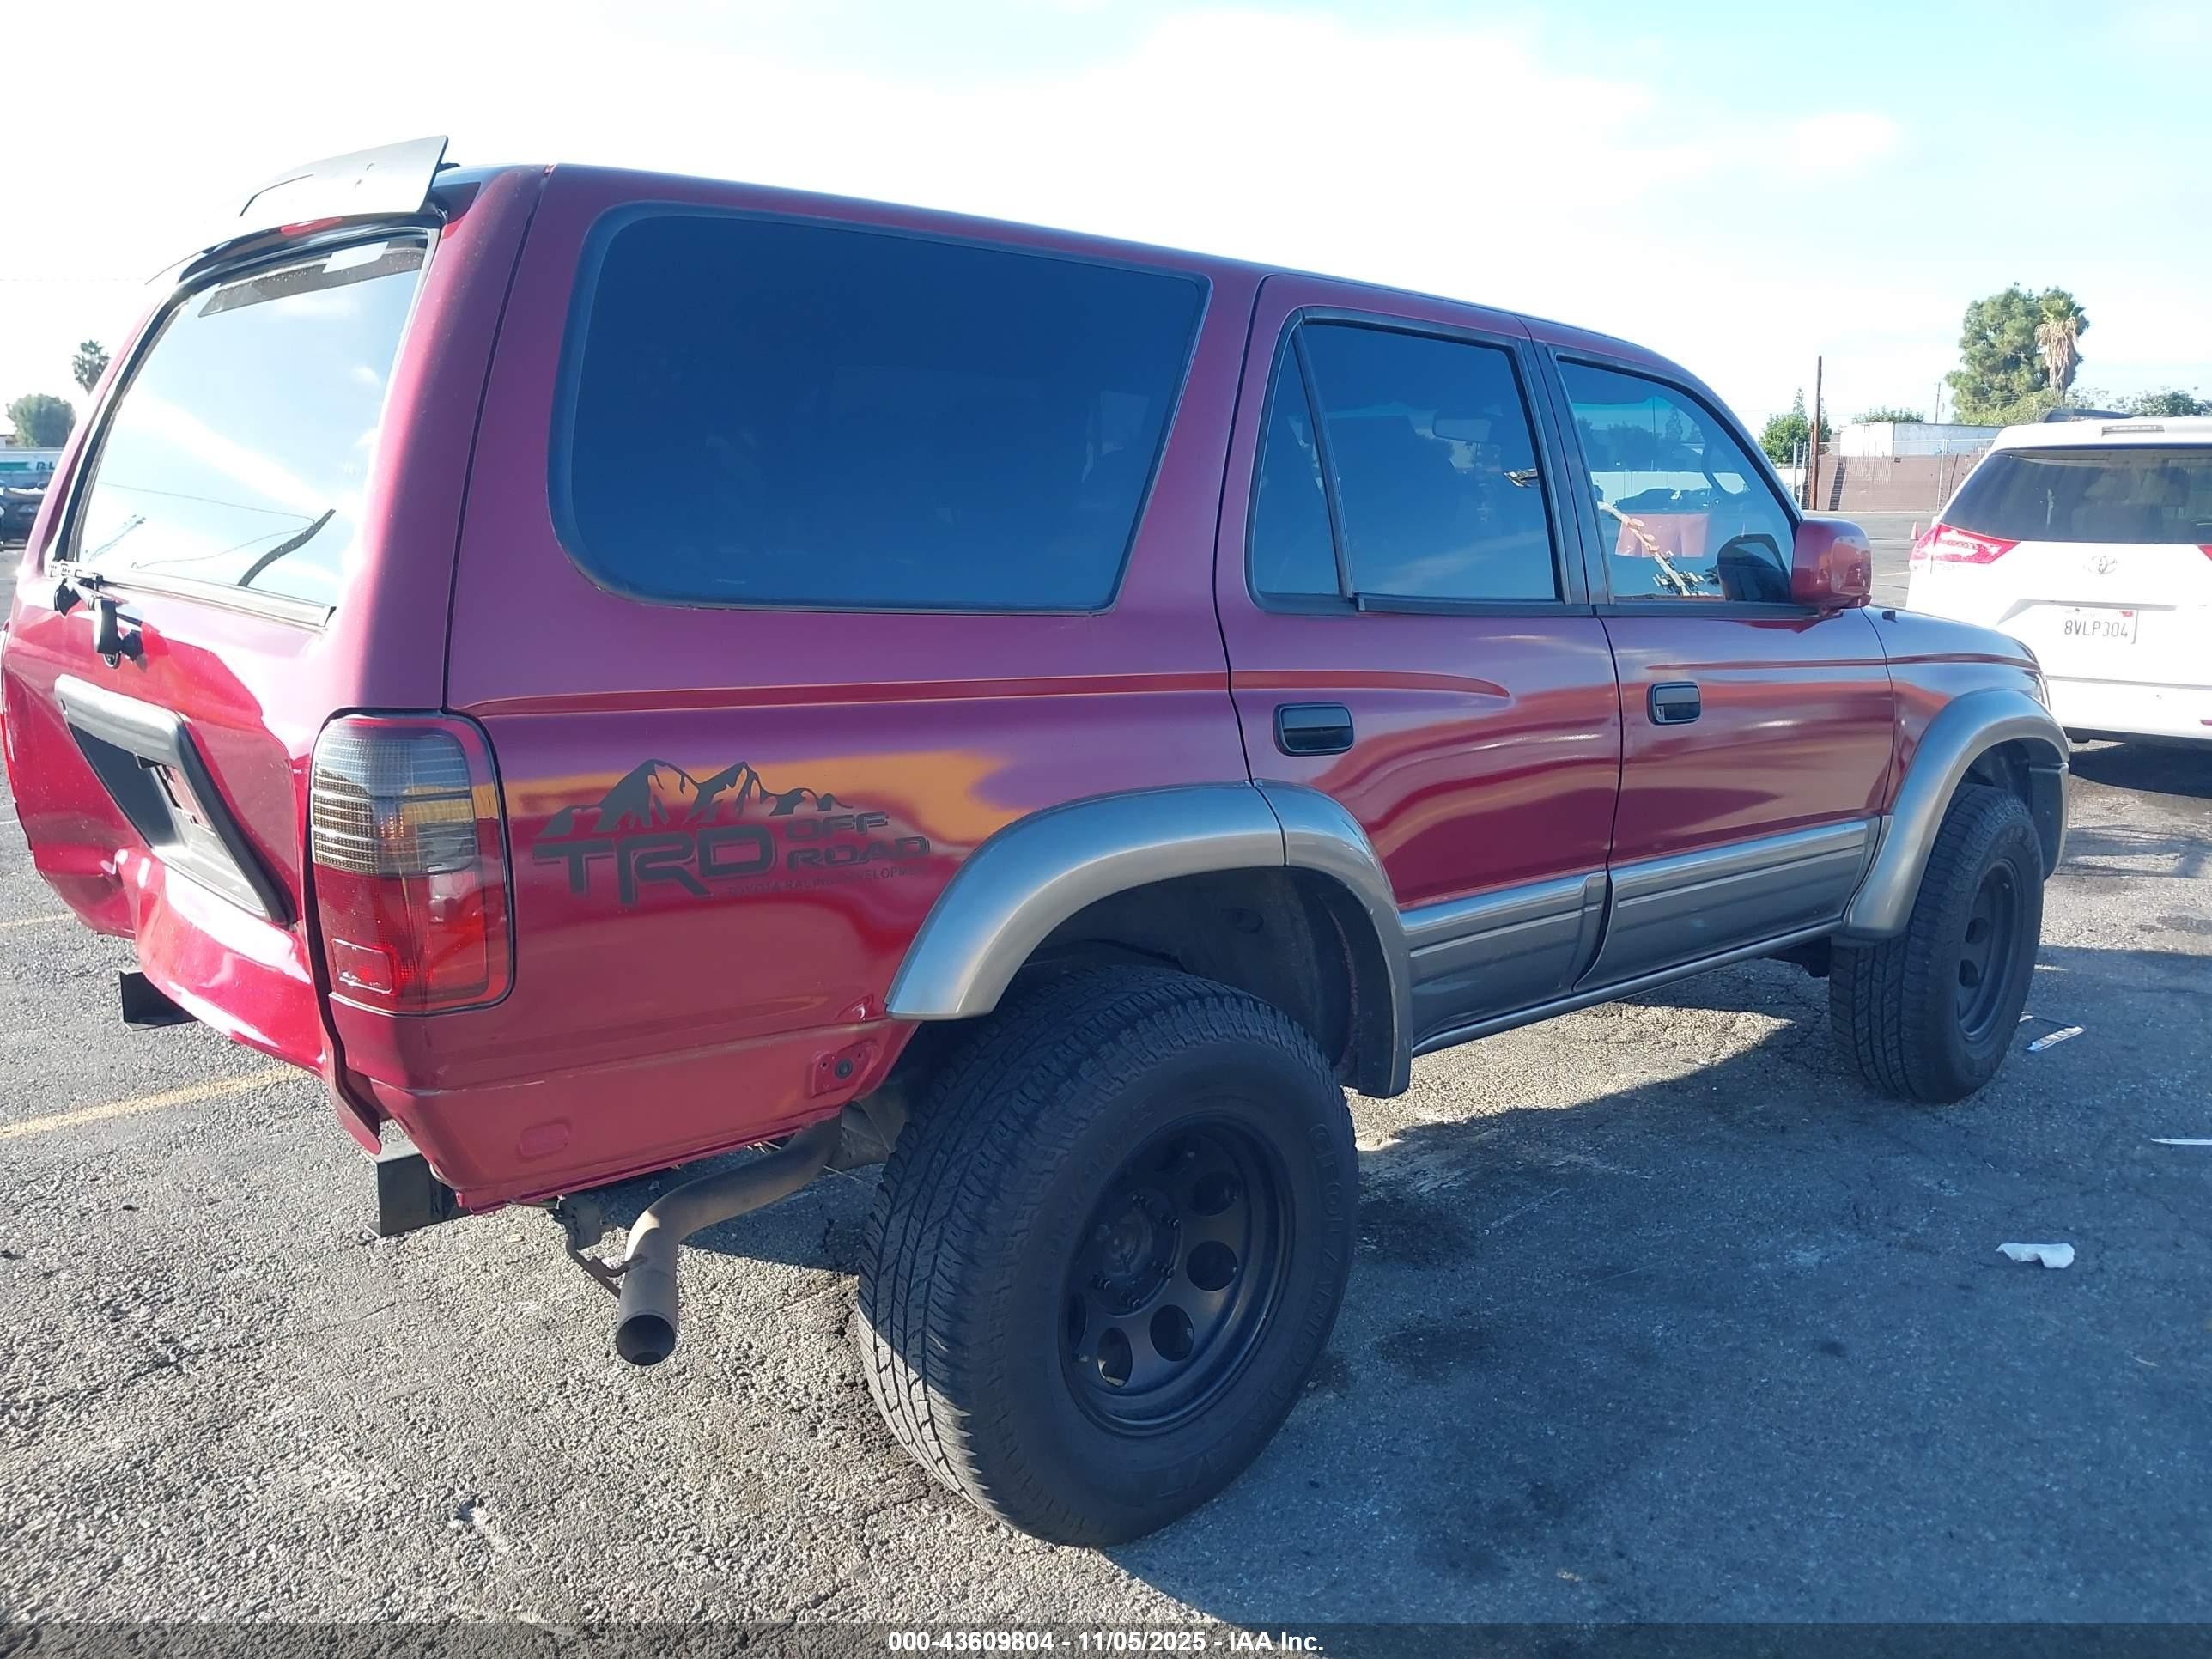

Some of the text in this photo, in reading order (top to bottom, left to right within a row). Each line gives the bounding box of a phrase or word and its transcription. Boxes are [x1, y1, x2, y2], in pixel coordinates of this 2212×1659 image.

[2064, 619, 2128, 637] 8VLP304
[785, 811, 890, 840] OFF
[532, 824, 778, 909] TRD
[787, 834, 931, 872] ROAD
